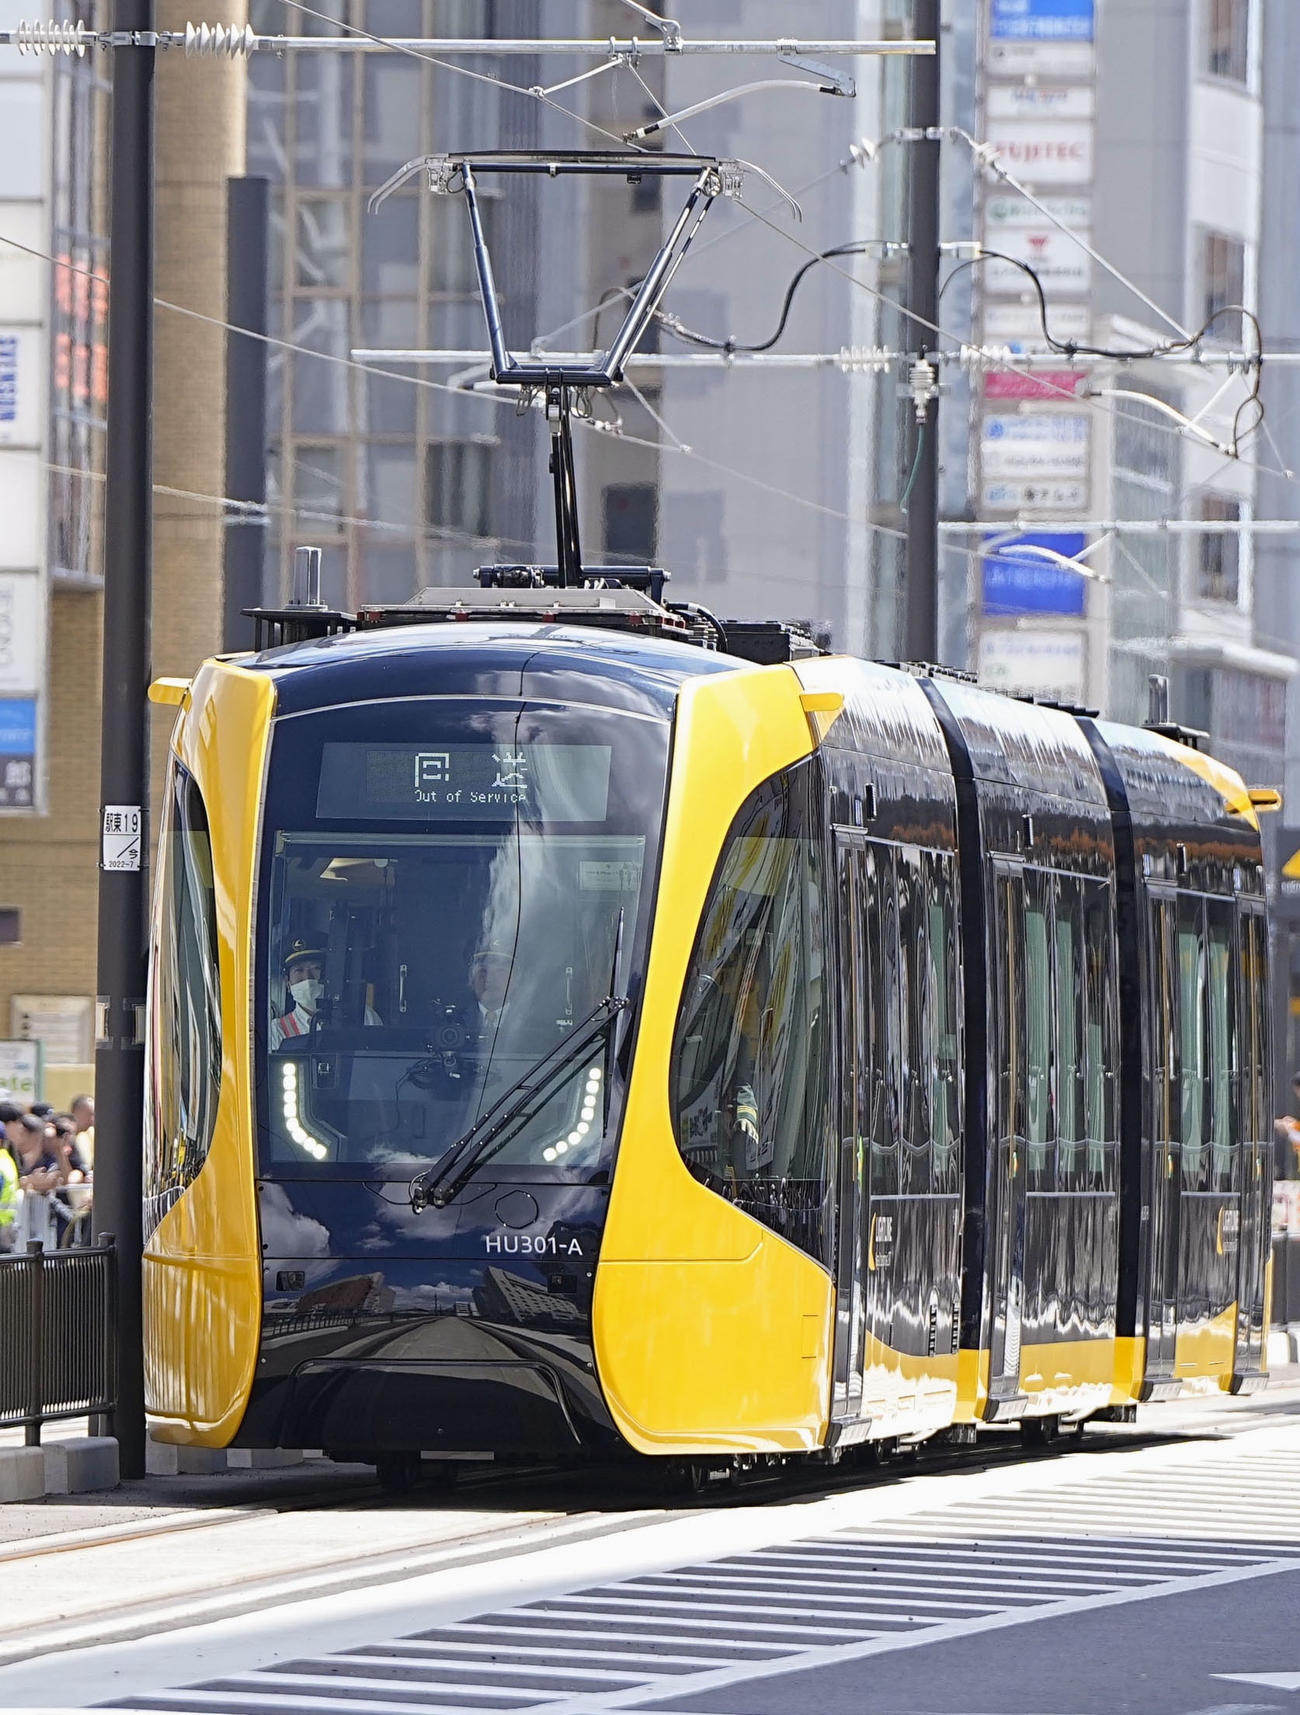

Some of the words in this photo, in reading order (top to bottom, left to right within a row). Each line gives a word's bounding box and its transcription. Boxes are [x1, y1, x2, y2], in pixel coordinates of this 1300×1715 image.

[414, 752, 528, 788] 回送
[446, 790, 463, 803] of
[470, 791, 526, 803] Service
[108, 860, 134, 868] 2022-7
[485, 1235, 583, 1255] HU301-A
